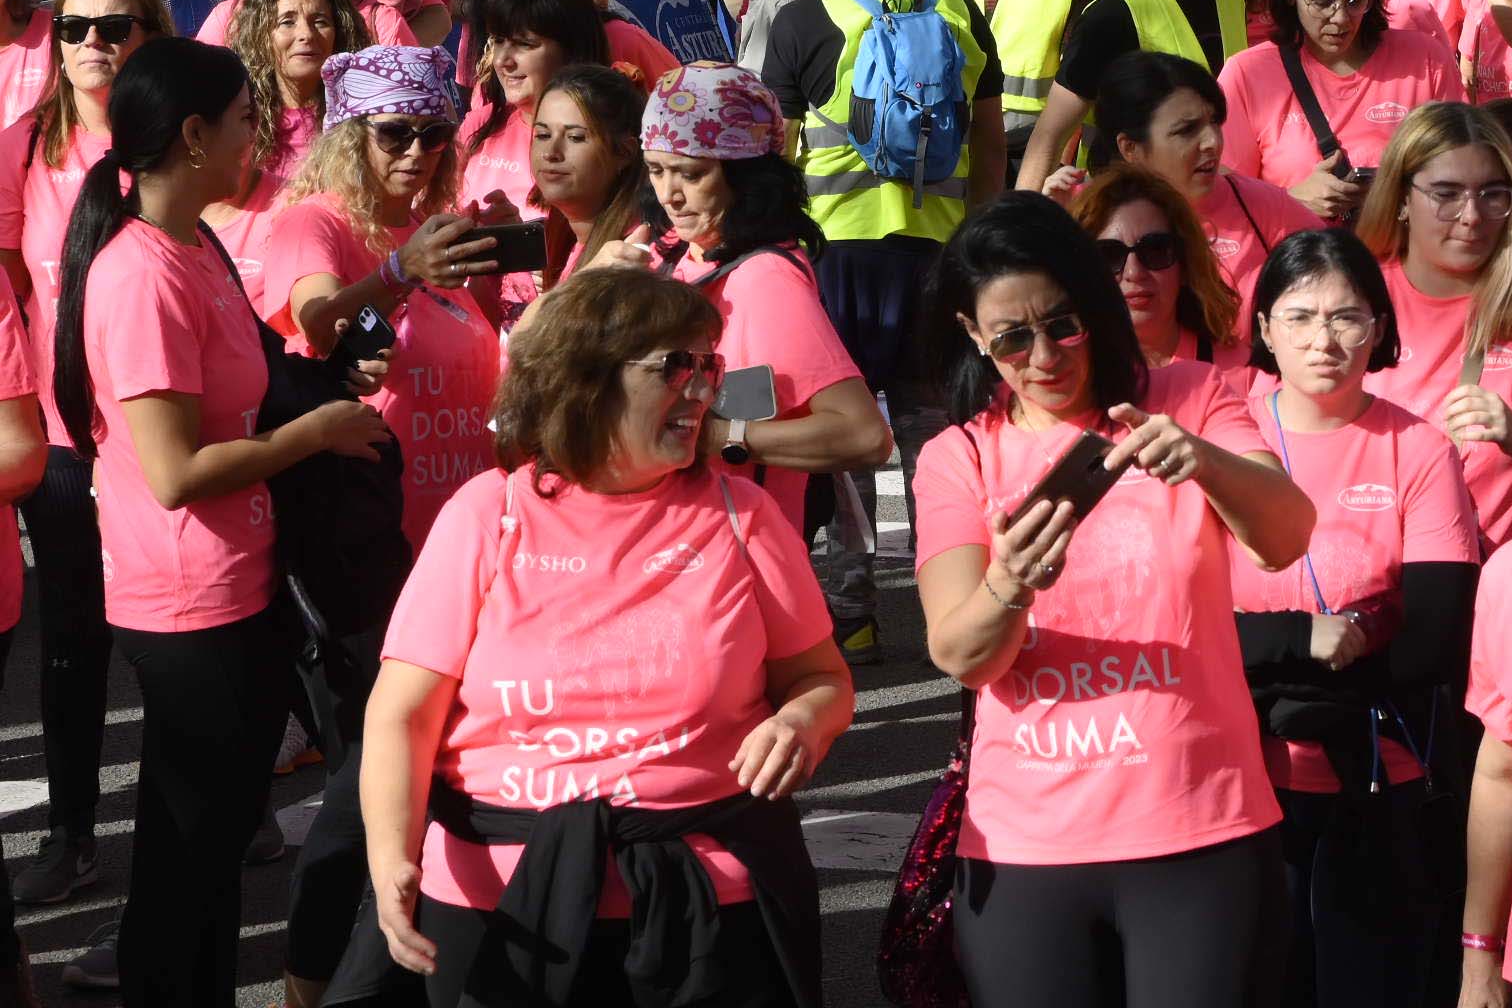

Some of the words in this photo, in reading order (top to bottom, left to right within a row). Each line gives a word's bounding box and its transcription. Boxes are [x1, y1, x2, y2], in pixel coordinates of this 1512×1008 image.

[408, 367, 444, 396] TU
[413, 452, 486, 486] SUMA
[512, 552, 587, 574] OYSHO
[1012, 647, 1182, 706] DORSAL
[493, 678, 555, 718] TU
[1014, 711, 1143, 760] SUMA
[499, 764, 641, 808] SUMA
